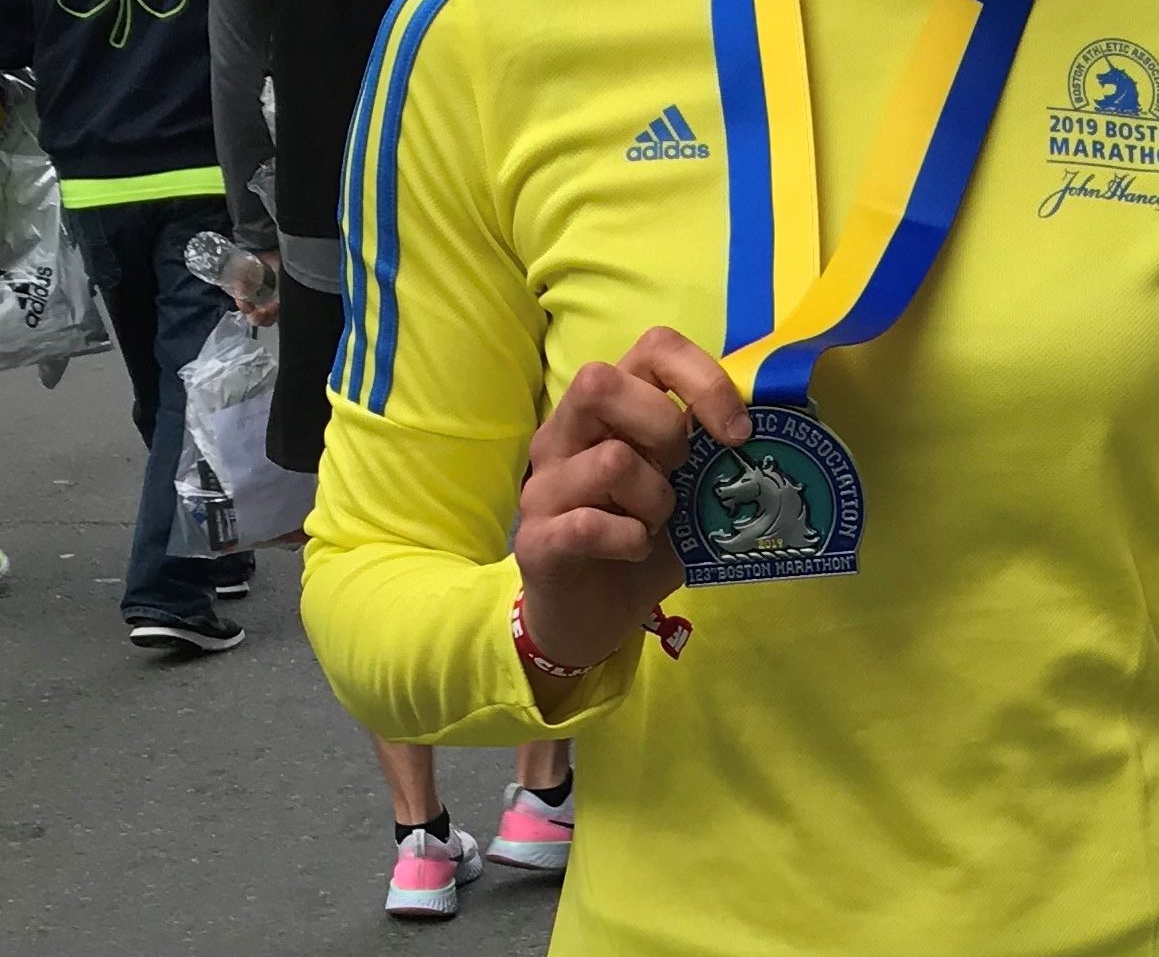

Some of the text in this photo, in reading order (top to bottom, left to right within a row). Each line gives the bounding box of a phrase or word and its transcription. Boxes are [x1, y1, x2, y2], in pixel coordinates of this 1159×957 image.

[1071, 62, 1084, 103] BOSTON
[1081, 42, 1130, 65] ATHLETIC
[1049, 115, 1098, 136] 2019
[626, 141, 711, 161] adidas
[1037, 168, 1101, 219] John
[25, 266, 54, 328] adidas
[782, 416, 860, 540] ASSOCIATION
[757, 538, 784, 550] 2019
[717, 563, 771, 581] BOSTON
